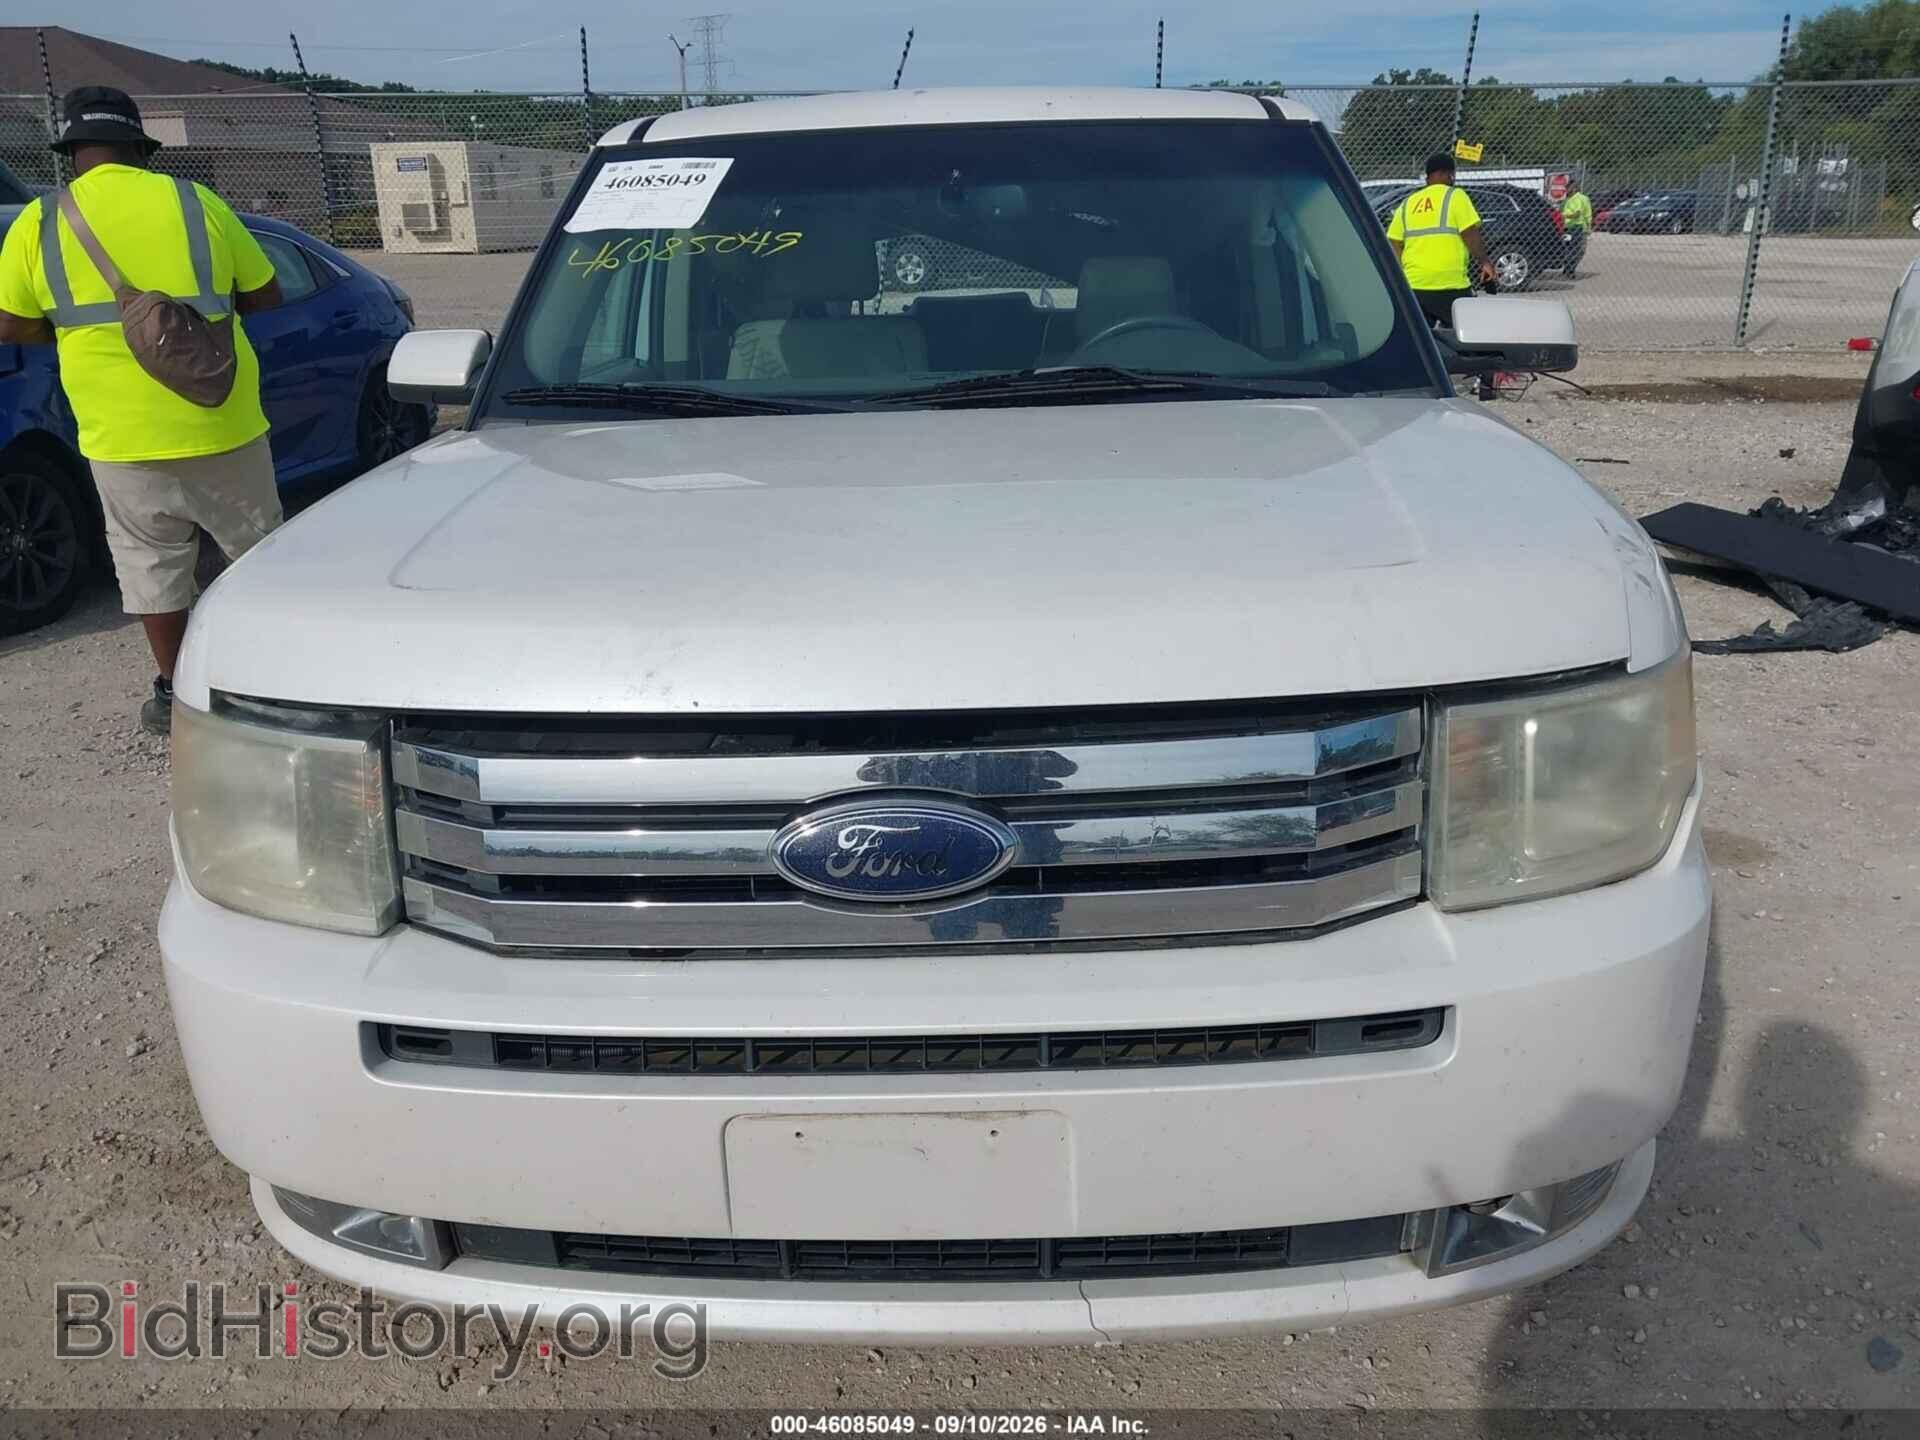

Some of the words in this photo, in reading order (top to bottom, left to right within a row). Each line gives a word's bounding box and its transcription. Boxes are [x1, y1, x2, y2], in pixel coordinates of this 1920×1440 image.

[603, 173, 707, 189] 46085049
[568, 231, 802, 278] 46085049
[825, 824, 955, 878] Ford
